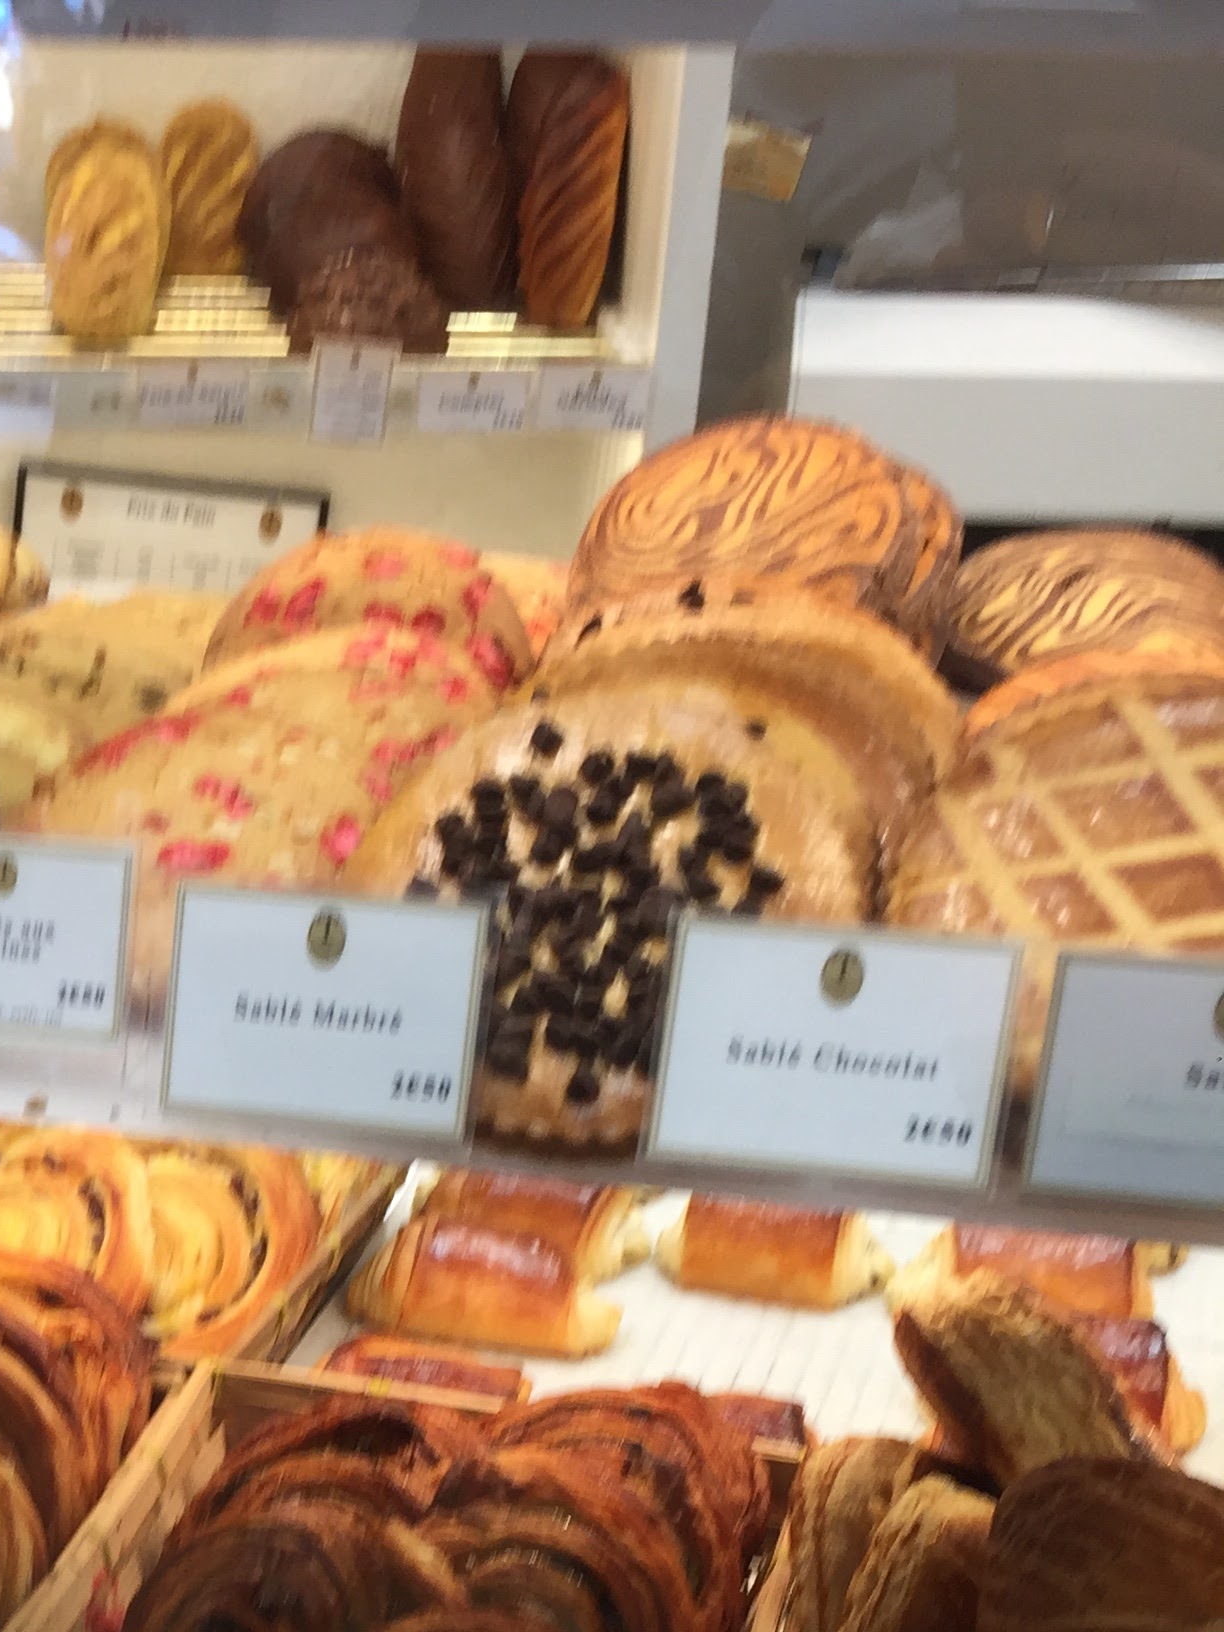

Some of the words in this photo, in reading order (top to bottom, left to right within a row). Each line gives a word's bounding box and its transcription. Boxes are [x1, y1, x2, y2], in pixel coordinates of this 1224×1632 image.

[234, 990, 302, 1027] Sablé
[313, 997, 403, 1036] Marbré
[727, 1034, 802, 1070] Sablé
[813, 1041, 939, 1082] Chocolat
[1184, 1060, 1224, 1092] Sa
